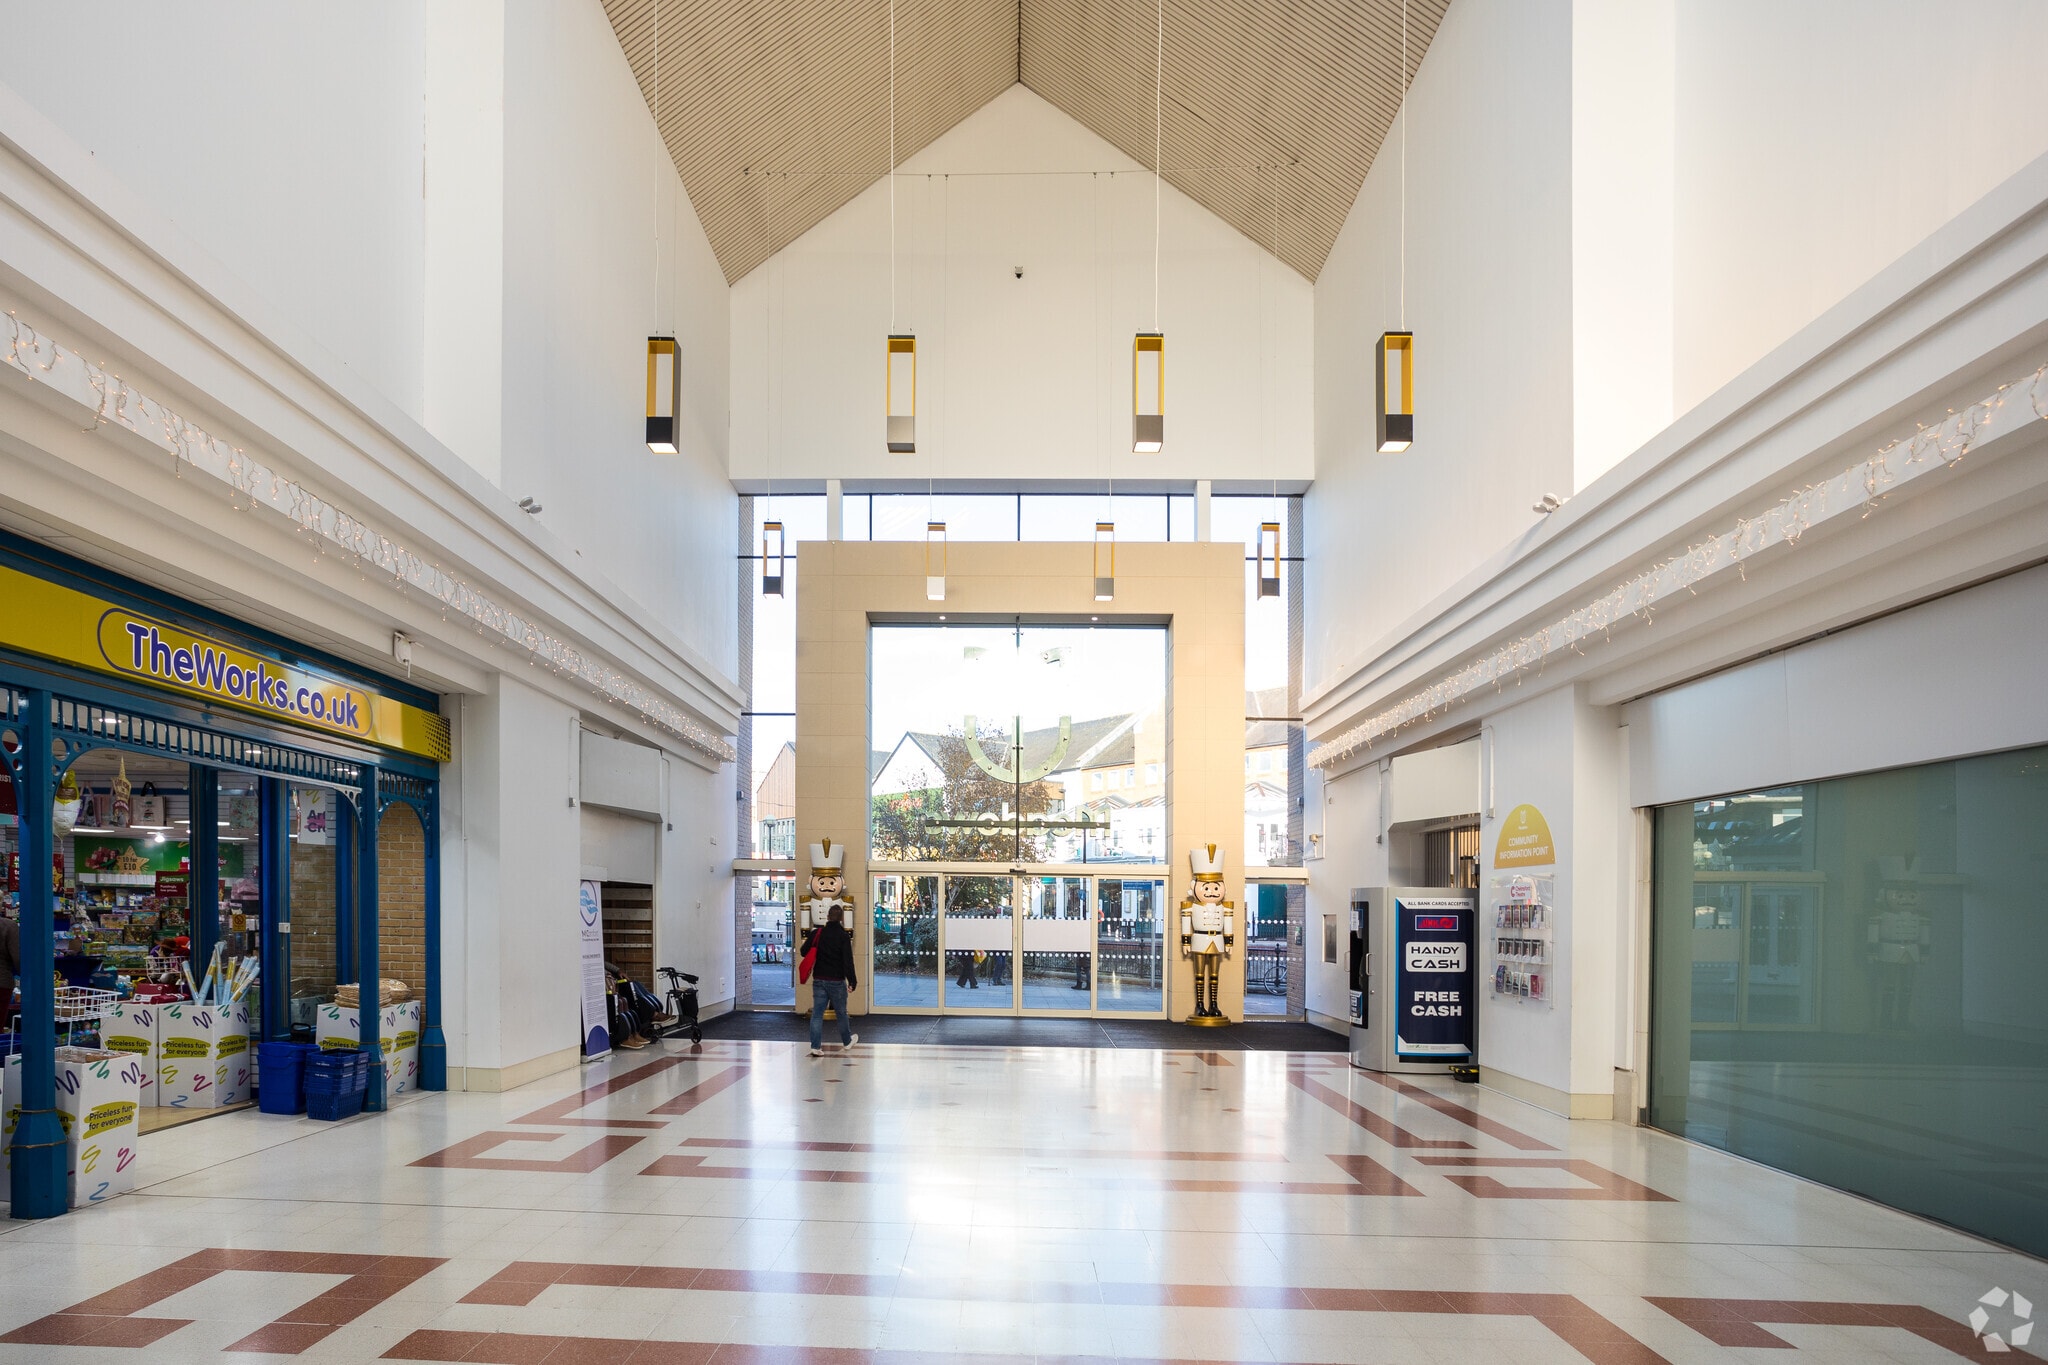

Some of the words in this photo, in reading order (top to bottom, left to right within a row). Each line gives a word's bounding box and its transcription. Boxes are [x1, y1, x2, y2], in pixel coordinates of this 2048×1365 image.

[126, 622, 360, 729] TheWorks.co.uk
[1508, 834, 1539, 847] COMMUNITY
[1500, 848, 1532, 860] INFORMATION
[1532, 846, 1549, 856] POINT
[123, 863, 137, 871] £10
[1411, 946, 1460, 955] HANDY
[1411, 959, 1460, 969] CASH
[1414, 991, 1460, 1002] FREE
[1411, 1005, 1462, 1017] CASH
[166, 1041, 194, 1049] Priceless
[322, 1040, 350, 1048] Priceless
[89, 1108, 120, 1121] Priceless
[121, 1105, 133, 1113] fun
[88, 1122, 99, 1131] for
[101, 1115, 132, 1128] everyone
